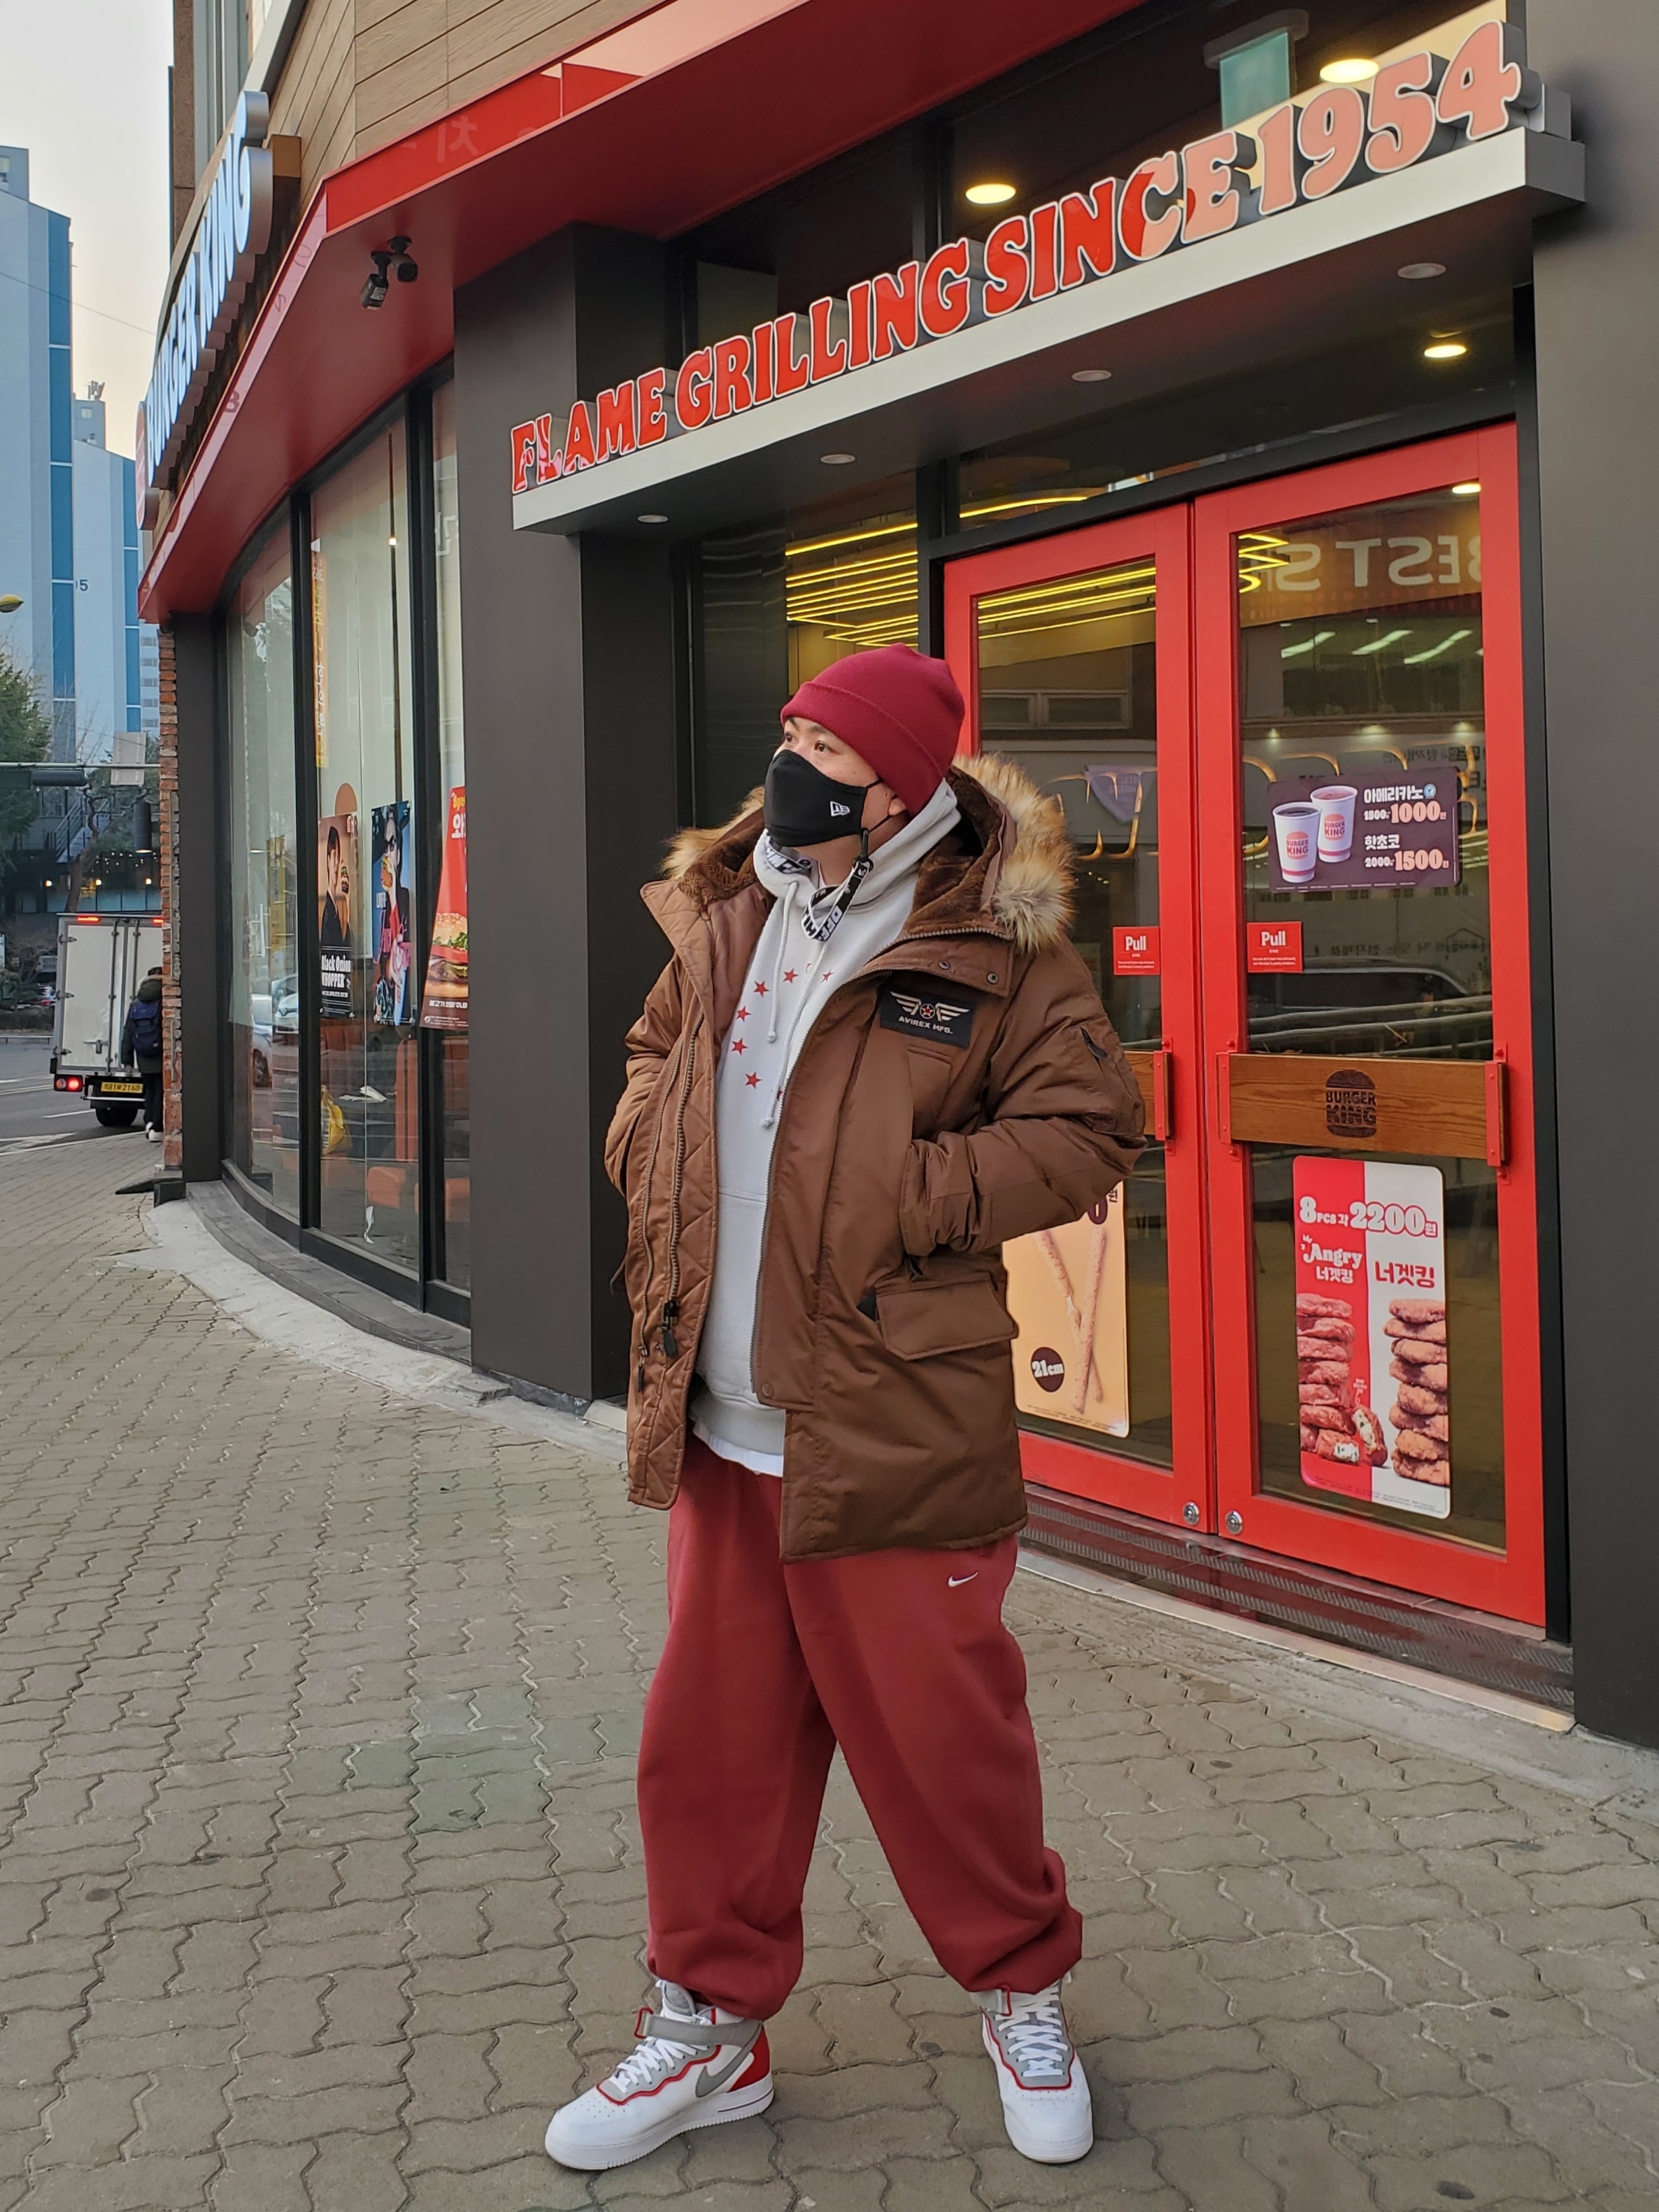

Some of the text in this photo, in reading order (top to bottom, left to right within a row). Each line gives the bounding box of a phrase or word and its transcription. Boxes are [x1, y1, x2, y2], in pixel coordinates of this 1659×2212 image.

[511, 20, 1521, 494] FLAME GRILLING SINCE 1954
[146, 90, 252, 487] BURGER KING
[1364, 785, 1424, 804] 아메리카노
[1324, 827, 1346, 836] KING
[1286, 845, 1309, 855] KING
[1365, 834, 1400, 850] 핫초코
[1125, 935, 1146, 951] Pull
[1261, 930, 1286, 946] Pull
[898, 1015, 953, 1034] AVIREX MFG.
[1325, 1091, 1376, 1106] BURGER
[1326, 1104, 1377, 1126] KING
[1337, 1213, 1349, 1227] 각
[1349, 1201, 1438, 1238] 2200원
[1302, 1243, 1363, 1269] Angry
[1316, 1265, 1354, 1284] 너겟킹
[1374, 1261, 1435, 1288] 너겟킹
[1032, 1360, 1065, 1378] 21cm
